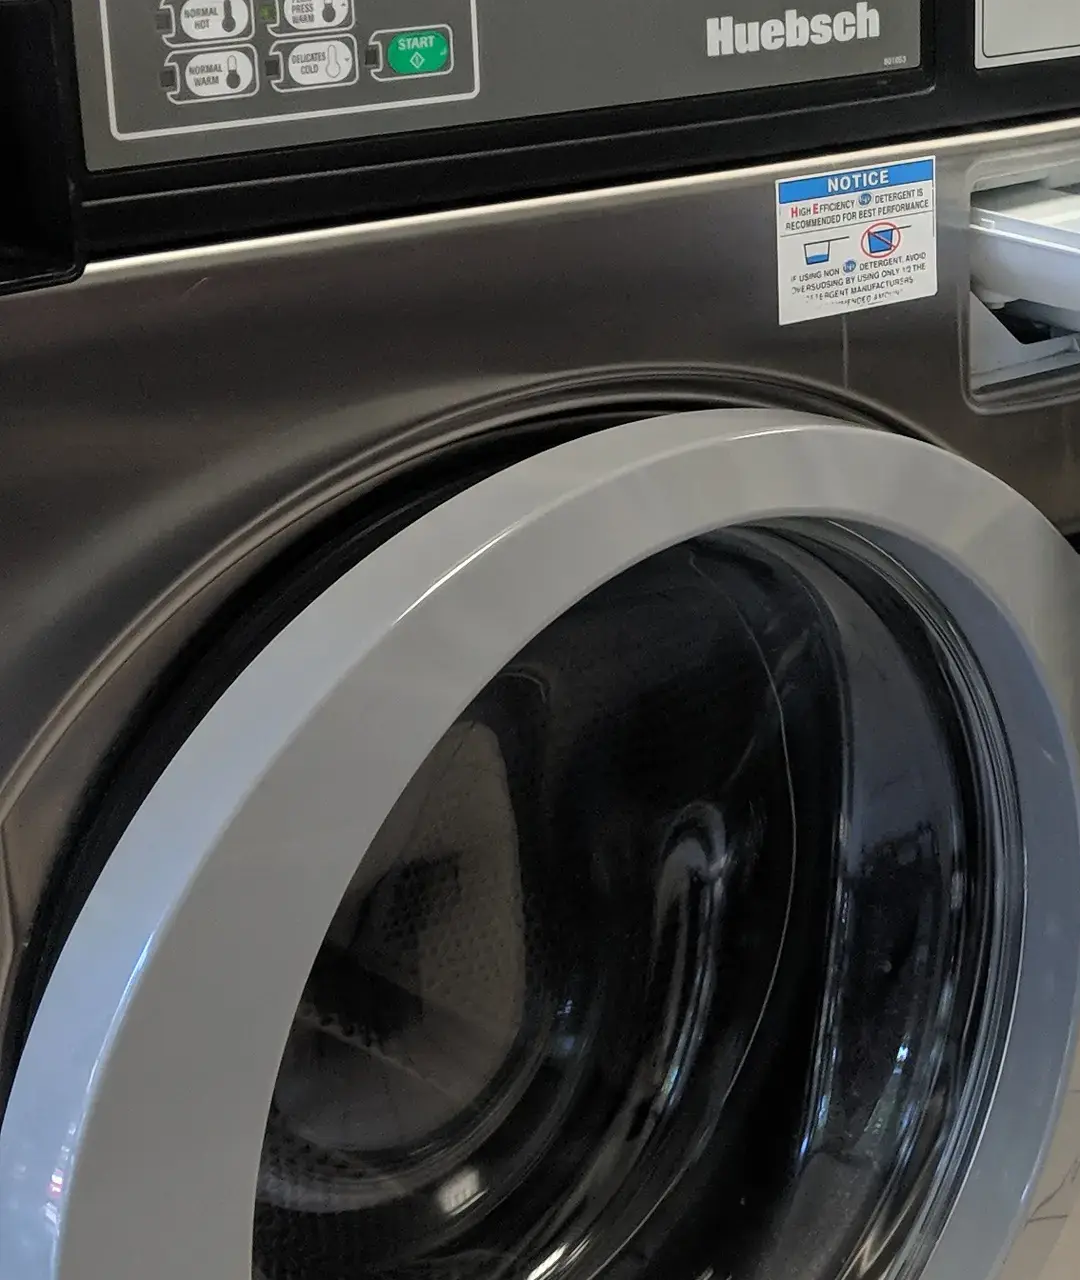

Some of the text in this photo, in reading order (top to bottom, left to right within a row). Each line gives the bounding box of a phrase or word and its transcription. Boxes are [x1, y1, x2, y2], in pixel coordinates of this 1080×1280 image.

[184, 7, 218, 19] NORMAL
[291, 4, 314, 14] PRESS
[194, 19, 210, 29] HOT
[291, 14, 315, 24] WARM
[706, 1, 881, 57] Huebsch
[397, 34, 435, 50] START
[291, 52, 326, 64] DELICATES
[188, 63, 222, 75] NORMAL
[300, 64, 319, 74] COLD
[193, 75, 220, 87] WARM
[827, 169, 889, 193] NOTICE
[791, 207, 811, 218] HIGH
[812, 200, 855, 215] EFFICIENCY
[875, 190, 915, 204] DETERGENT
[917, 187, 924, 196] IS
[785, 214, 841, 231] RECOMMENDED
[842, 211, 857, 222] FOR
[858, 208, 873, 220] BEST
[877, 199, 929, 216] PERFORMANCE
[799, 270, 822, 282] USING
[823, 267, 840, 277] NON
[905, 251, 927, 262] AVOID
[845, 276, 855, 285] BY
[857, 271, 880, 283] USING
[881, 268, 900, 278] ONLY
[912, 262, 926, 271] THE
[806, 287, 849, 301] TERGENT
